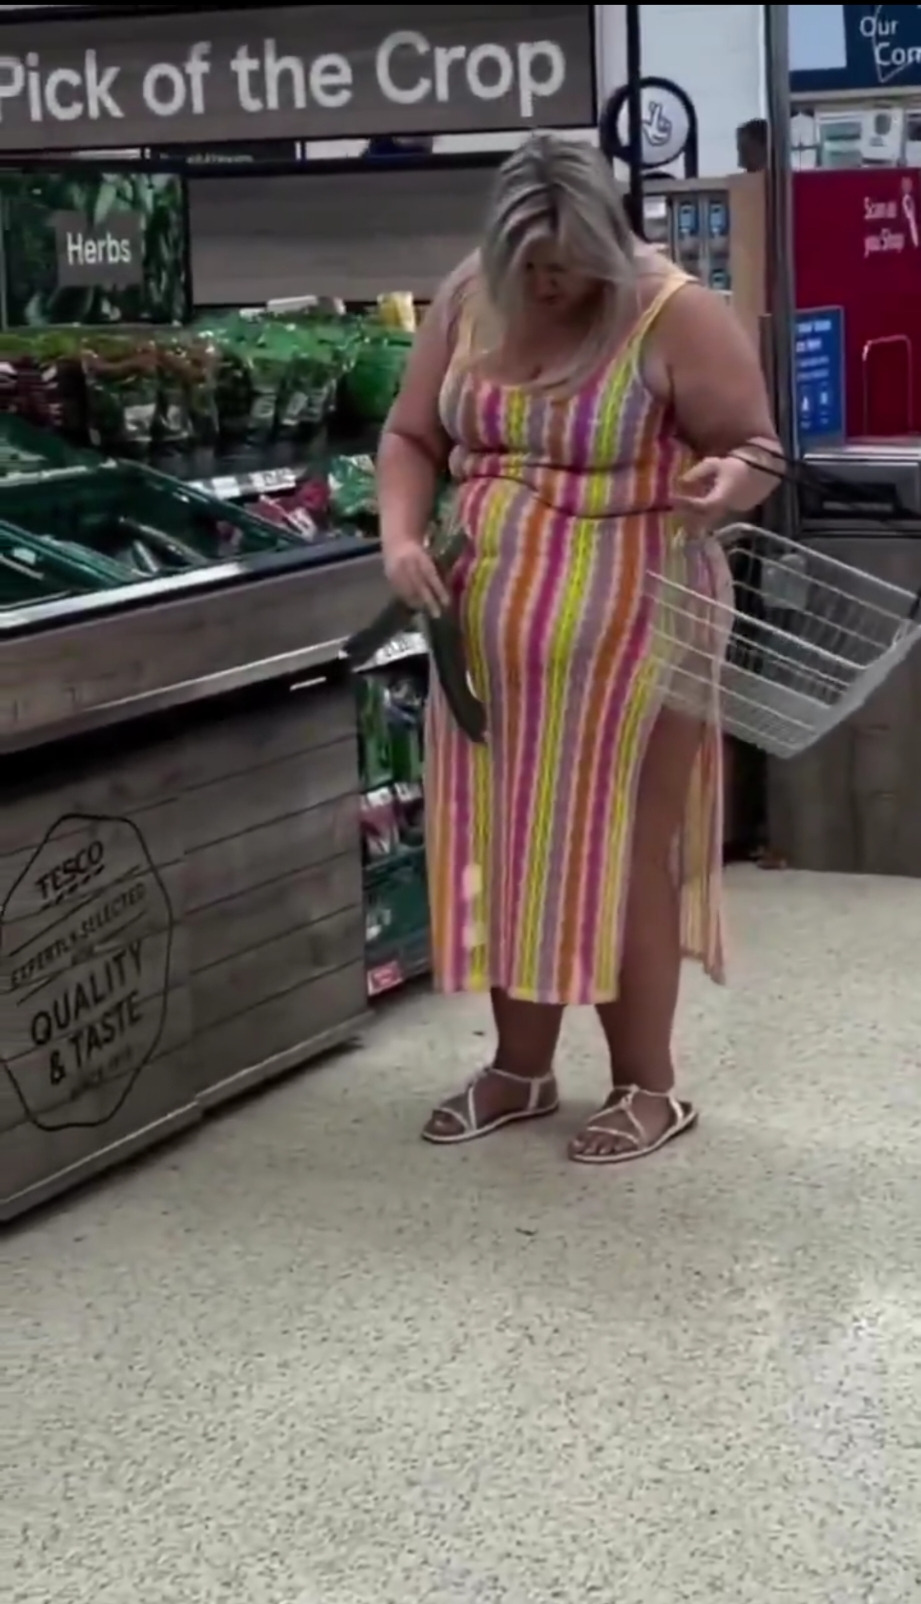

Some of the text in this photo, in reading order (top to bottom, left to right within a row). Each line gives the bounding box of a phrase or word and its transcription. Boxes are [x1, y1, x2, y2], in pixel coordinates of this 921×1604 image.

[860, 16, 899, 37] Our
[0, 31, 567, 122] Pick of the Crop
[66, 231, 132, 265] Herbs
[35, 841, 104, 899] TESCO
[80, 882, 146, 938] SELECTED
[31, 940, 142, 1046] QUALITY
[50, 1050, 65, 1085] &
[68, 991, 143, 1069] TASTE
